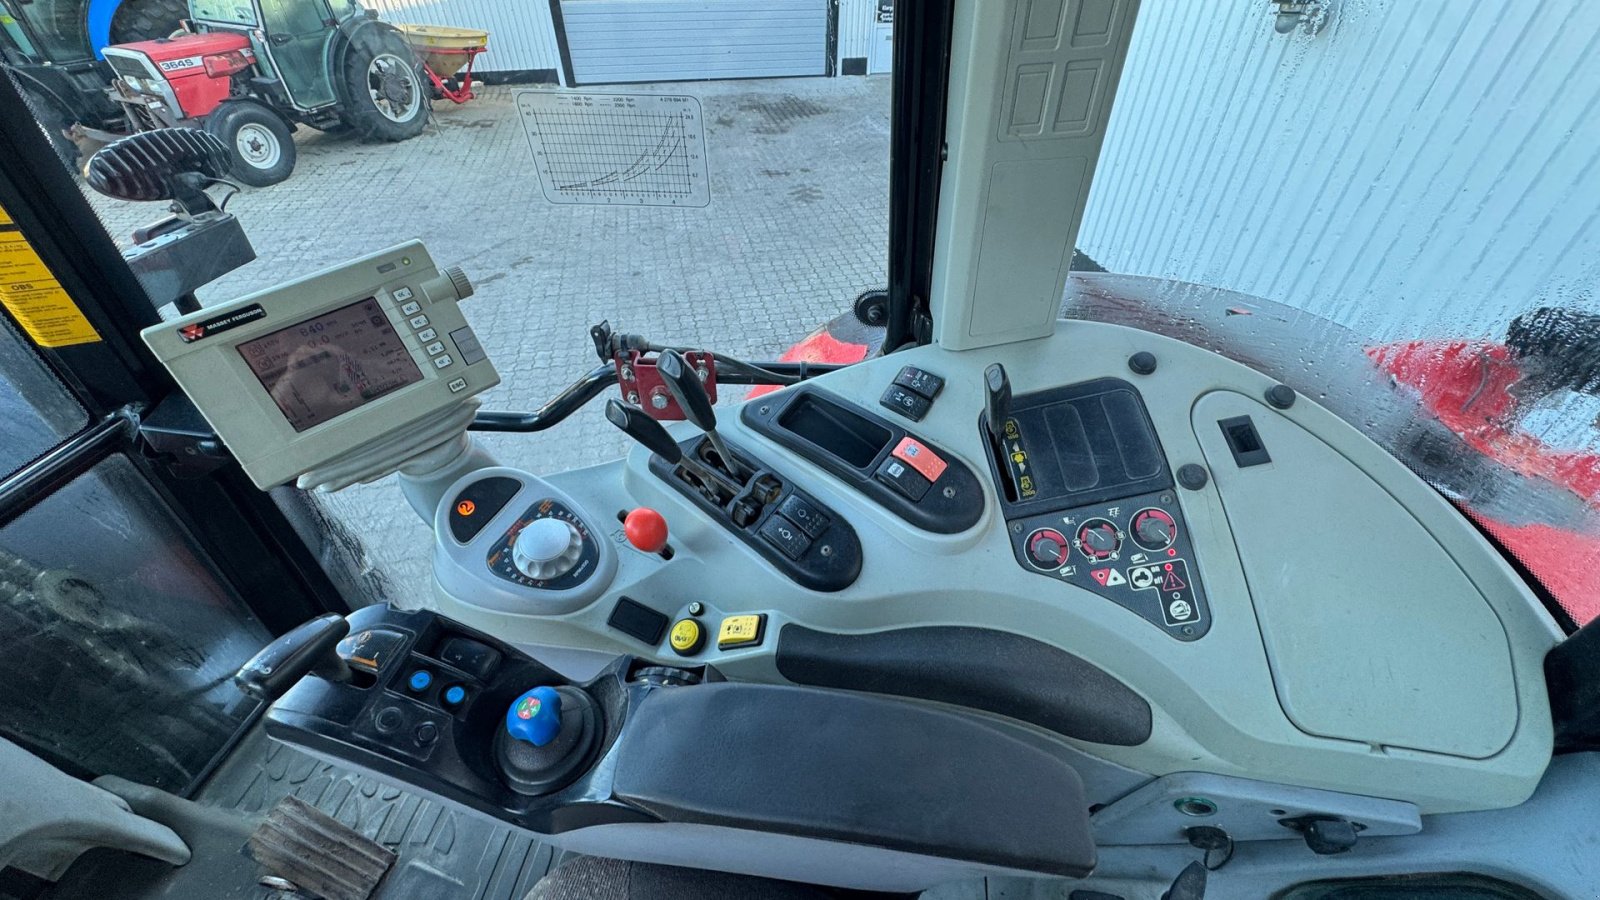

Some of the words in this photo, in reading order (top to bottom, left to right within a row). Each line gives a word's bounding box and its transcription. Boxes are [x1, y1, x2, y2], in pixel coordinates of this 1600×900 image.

[161, 59, 194, 71] 364S
[11, 283, 34, 291] OBS
[206, 319, 231, 330] MASSEY
[232, 308, 263, 322] FERGUSON
[299, 322, 324, 337] 840
[451, 381, 465, 390] ESC
[459, 502, 473, 513] 2
